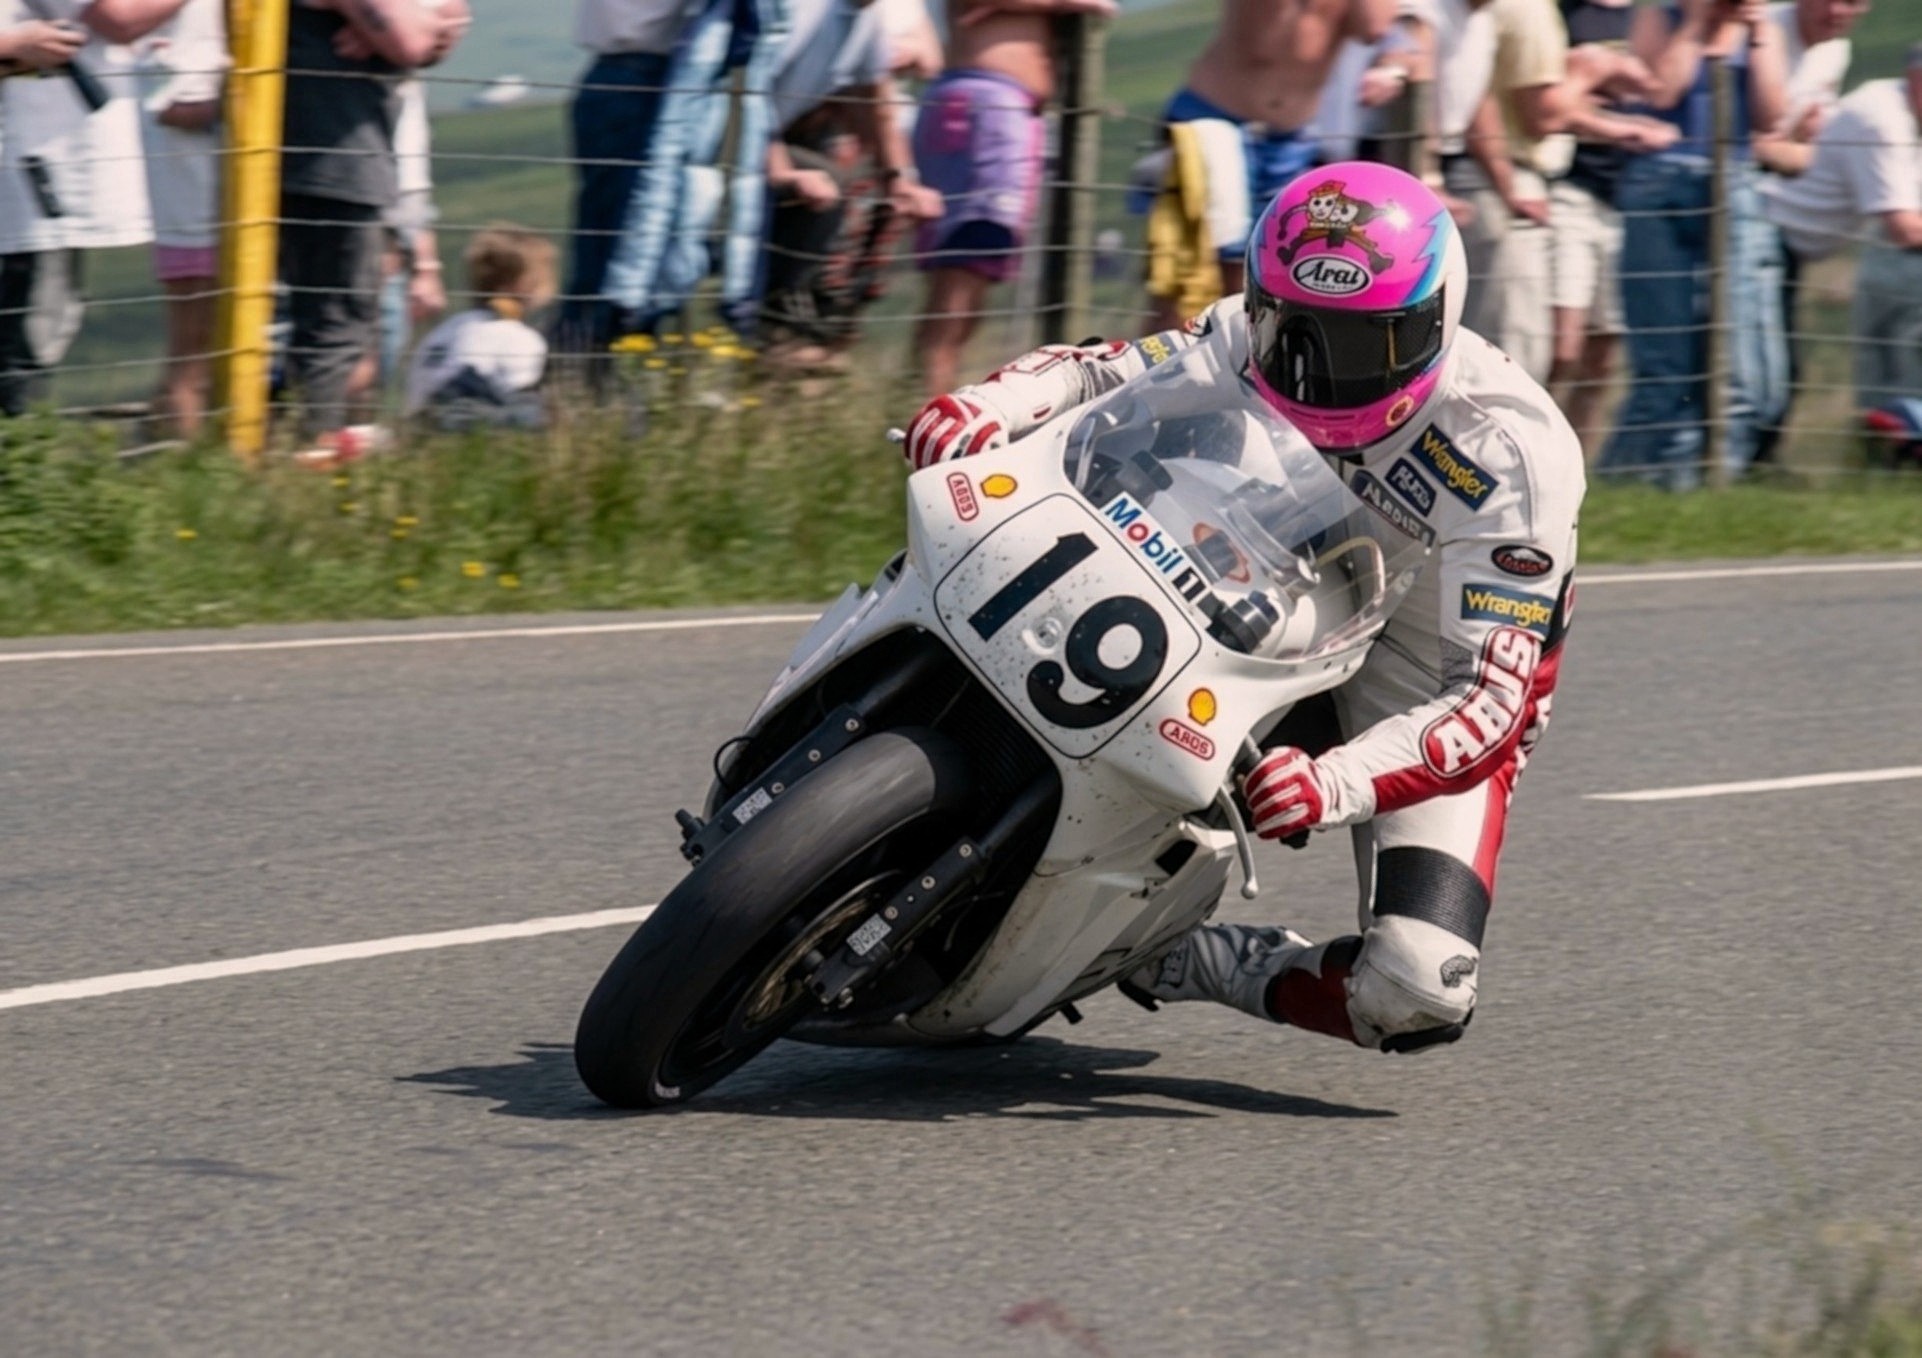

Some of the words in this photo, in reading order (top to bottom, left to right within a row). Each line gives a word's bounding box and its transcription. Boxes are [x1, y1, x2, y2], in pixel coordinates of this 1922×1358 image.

[1299, 260, 1359, 284] Arai
[1422, 430, 1489, 499] Wrangler
[1104, 498, 1184, 574] Mobil
[1176, 569, 1203, 600] 1
[967, 531, 1169, 729] 19
